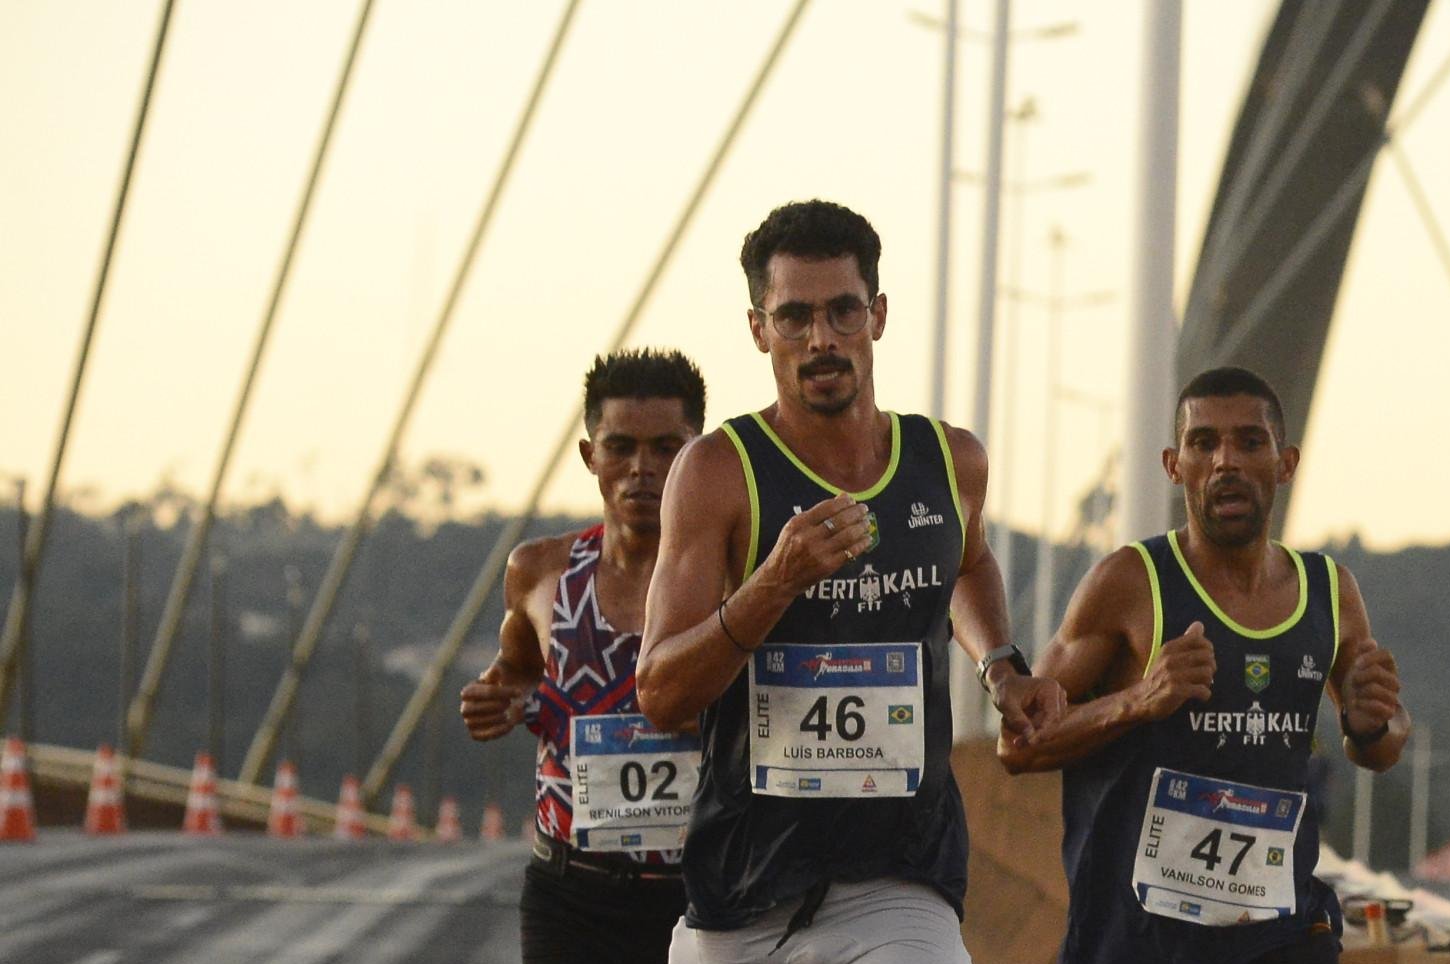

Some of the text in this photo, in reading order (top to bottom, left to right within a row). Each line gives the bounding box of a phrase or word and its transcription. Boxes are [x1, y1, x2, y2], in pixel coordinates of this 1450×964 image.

[857, 600, 883, 613] FIT
[756, 693, 770, 739] ELITE
[799, 695, 866, 742] 46
[816, 747, 884, 759] BARBOSA
[1243, 734, 1267, 745] FIT
[577, 763, 589, 805] ELITE
[620, 761, 679, 802] 02
[590, 807, 651, 820] RENILSON
[1145, 814, 1165, 859] ELITE
[1190, 828, 1257, 876] 47
[1160, 867, 1266, 897] VANILSON GOMES
